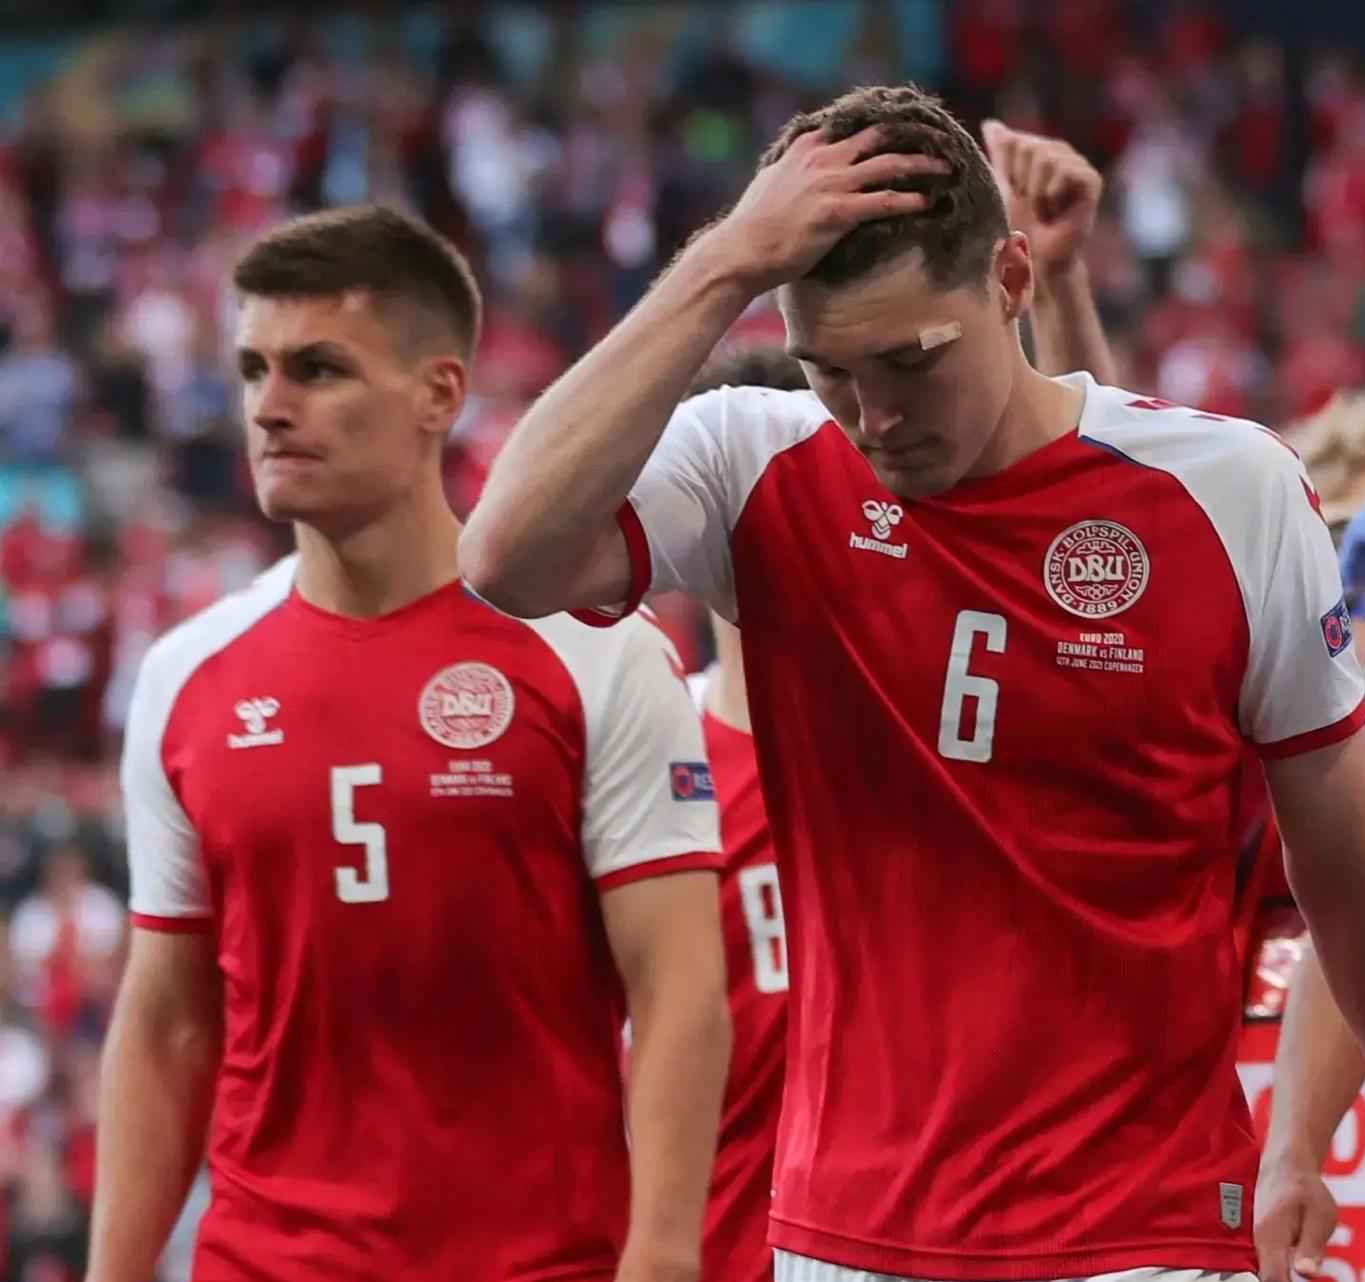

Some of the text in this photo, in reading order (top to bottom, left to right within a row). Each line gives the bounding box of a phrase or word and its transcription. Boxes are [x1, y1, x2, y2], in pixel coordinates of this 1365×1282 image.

[849, 531, 908, 559] hummel
[1050, 552, 1073, 604] DANSK
[1068, 554, 1125, 582] DBU
[1078, 601, 1118, 613] 1889
[1057, 641, 1098, 657] DENMARK
[1109, 648, 1144, 661] FINLAND
[1079, 633, 1124, 645] EURO 2020
[937, 609, 1008, 763] 6
[330, 763, 389, 904] 5
[738, 862, 790, 993] 8
